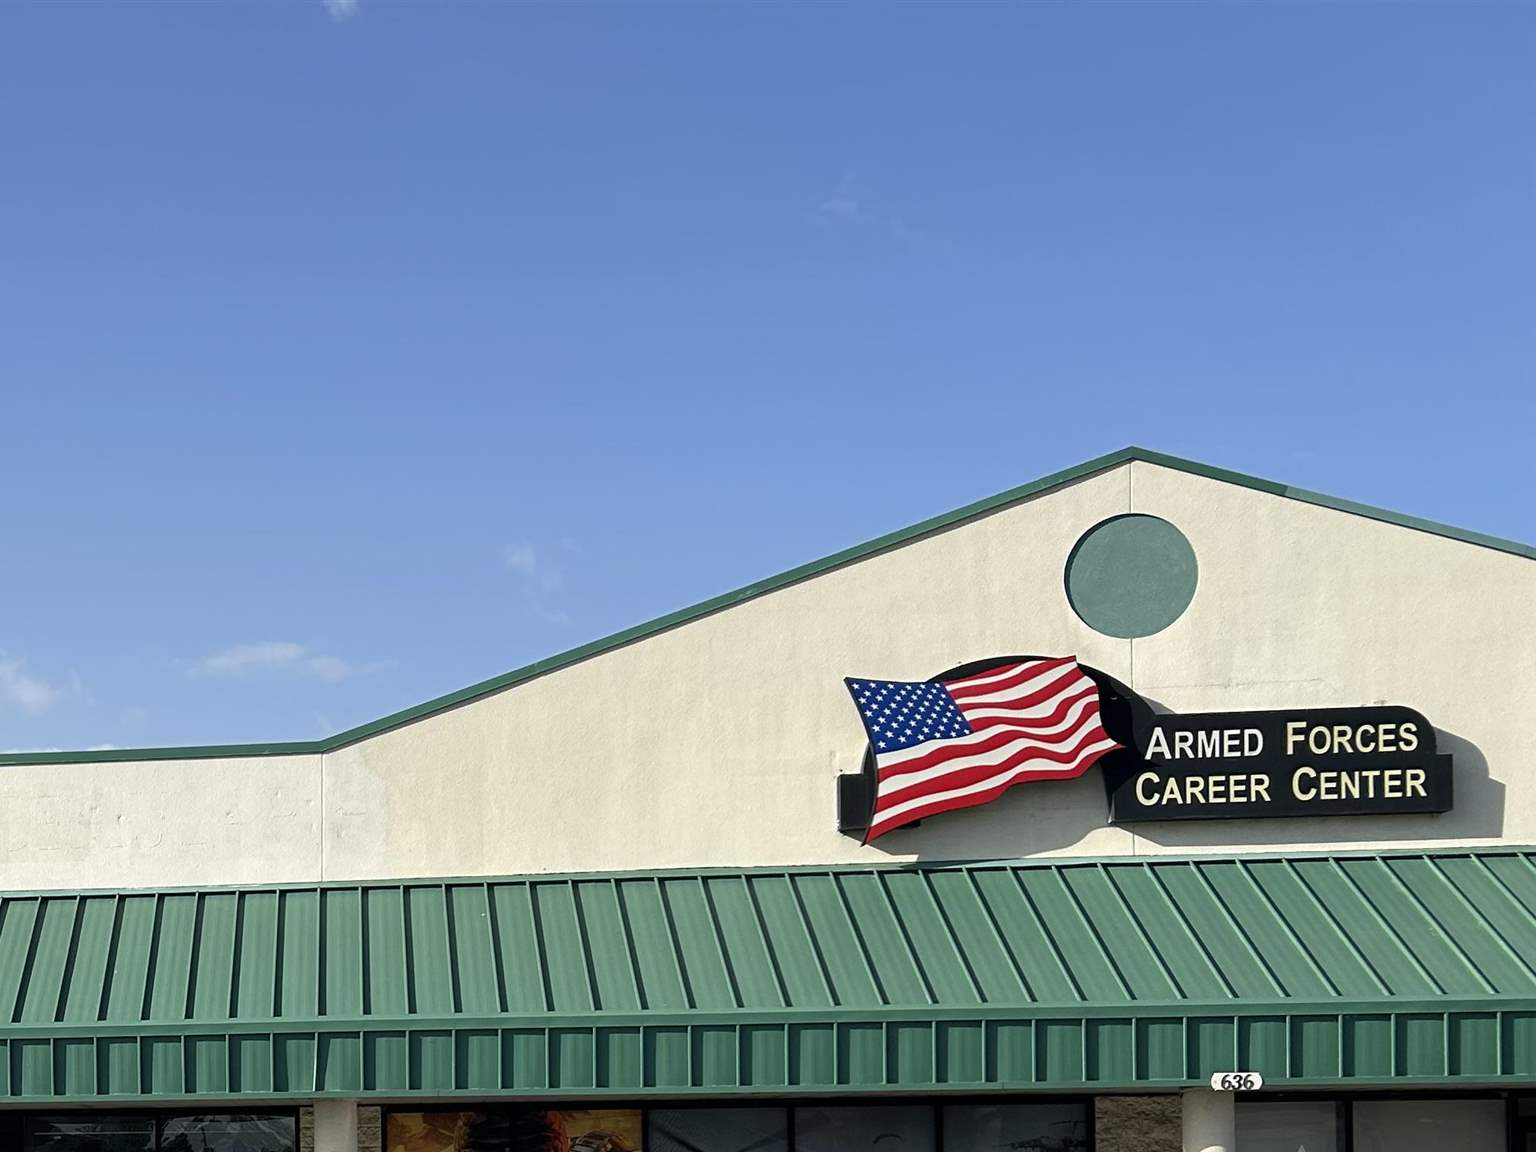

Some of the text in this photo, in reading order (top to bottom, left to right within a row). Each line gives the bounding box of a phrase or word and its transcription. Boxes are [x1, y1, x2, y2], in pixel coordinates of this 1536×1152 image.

[1144, 720, 1418, 761] ARMED FORCES
[1135, 766, 1428, 807] CAREER CENTER
[1221, 1074, 1255, 1090] 636
